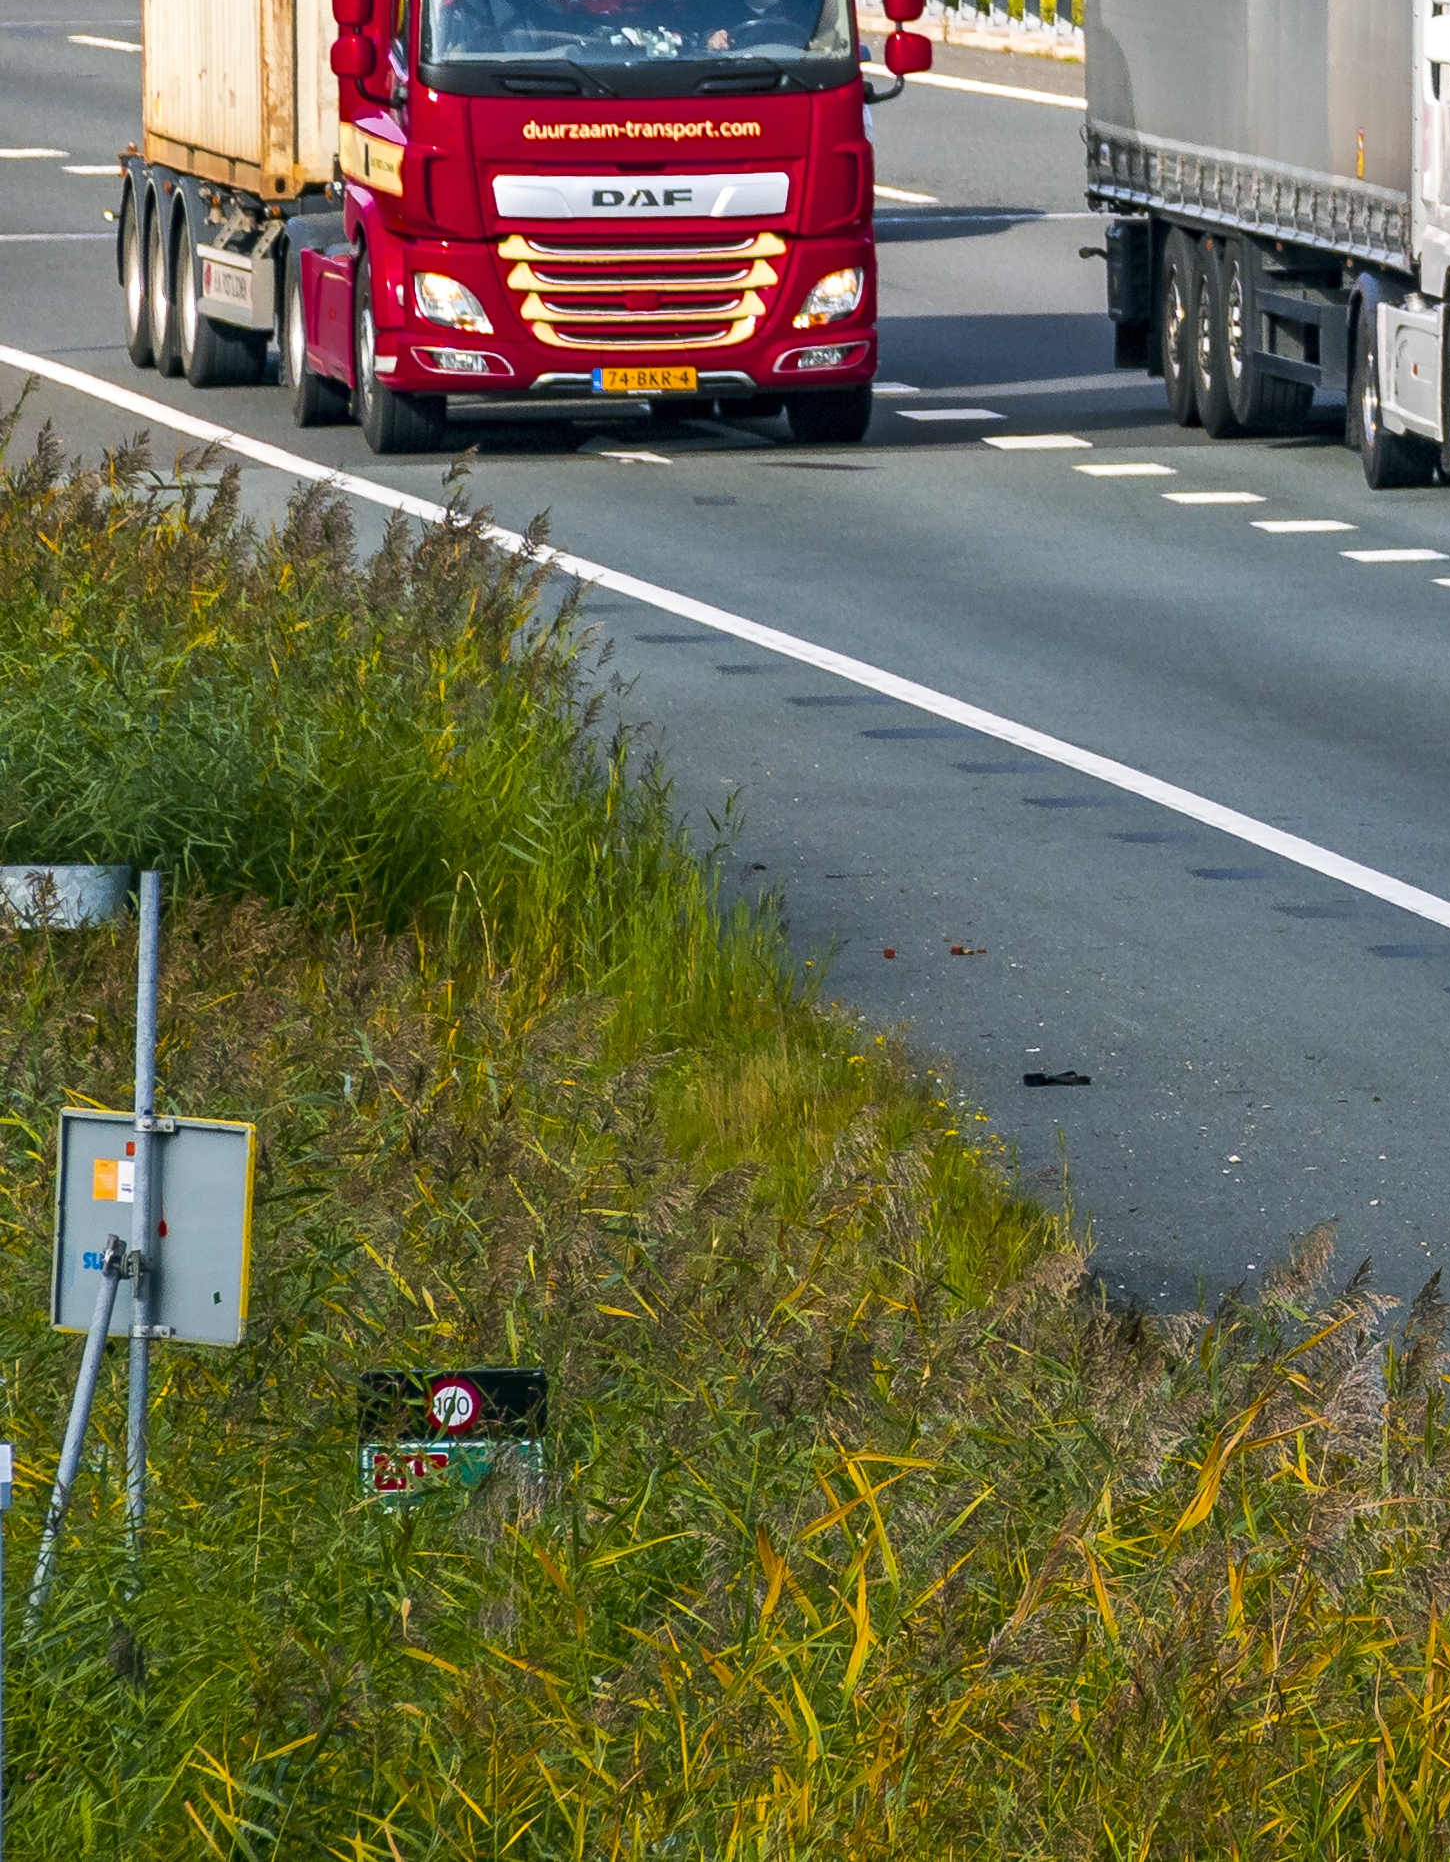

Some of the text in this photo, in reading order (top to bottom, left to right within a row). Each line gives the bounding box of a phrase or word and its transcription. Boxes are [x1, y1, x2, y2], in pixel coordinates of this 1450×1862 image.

[523, 120, 761, 142] duurzaam-transport.com
[591, 188, 693, 206] DAF
[608, 370, 690, 386] 74-BKR-4
